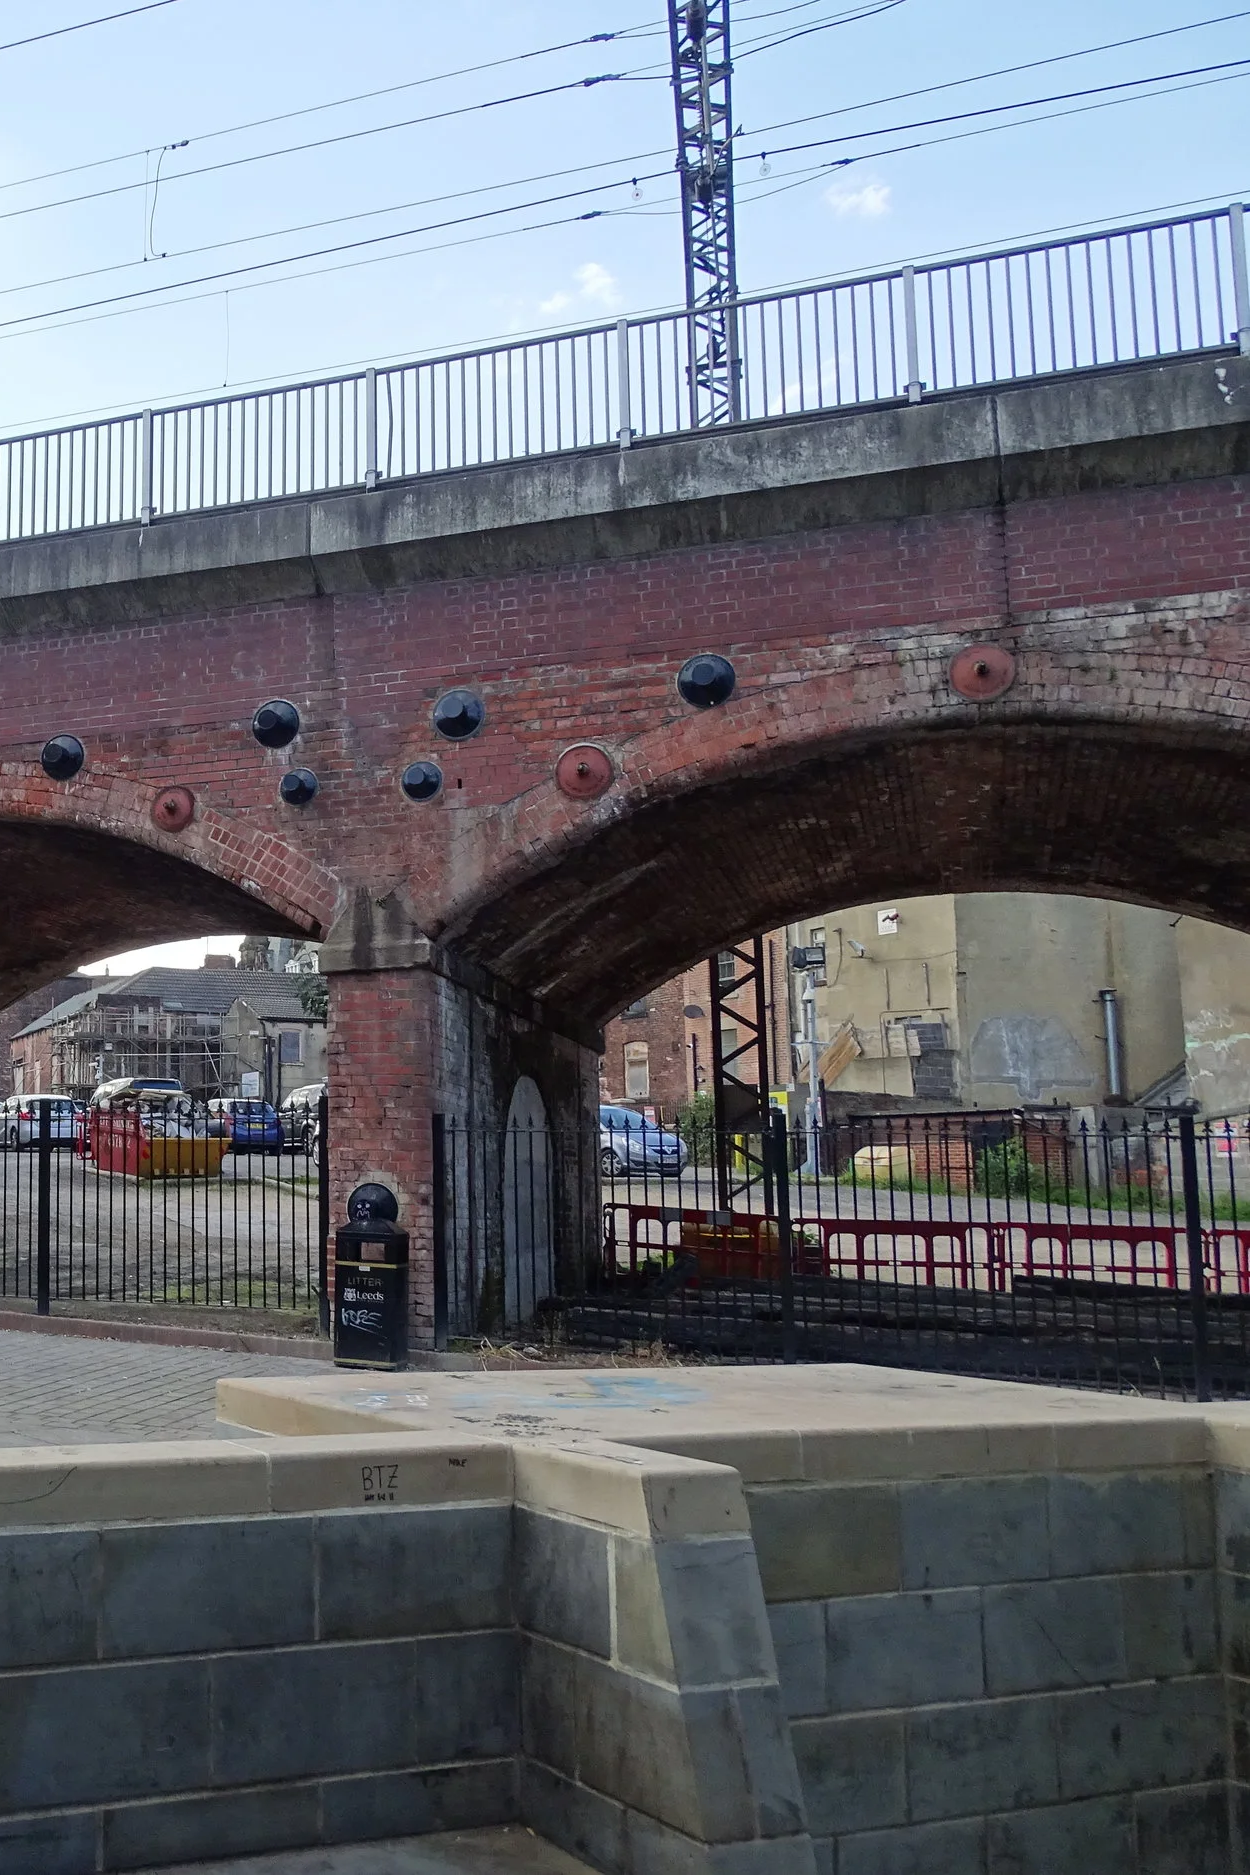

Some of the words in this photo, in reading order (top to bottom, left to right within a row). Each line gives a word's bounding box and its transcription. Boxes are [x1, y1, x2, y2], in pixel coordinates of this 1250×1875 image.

[347, 1276, 383, 1287] LITTER
[357, 1290, 384, 1301] Leeds
[361, 1464, 399, 1491] BTZ
